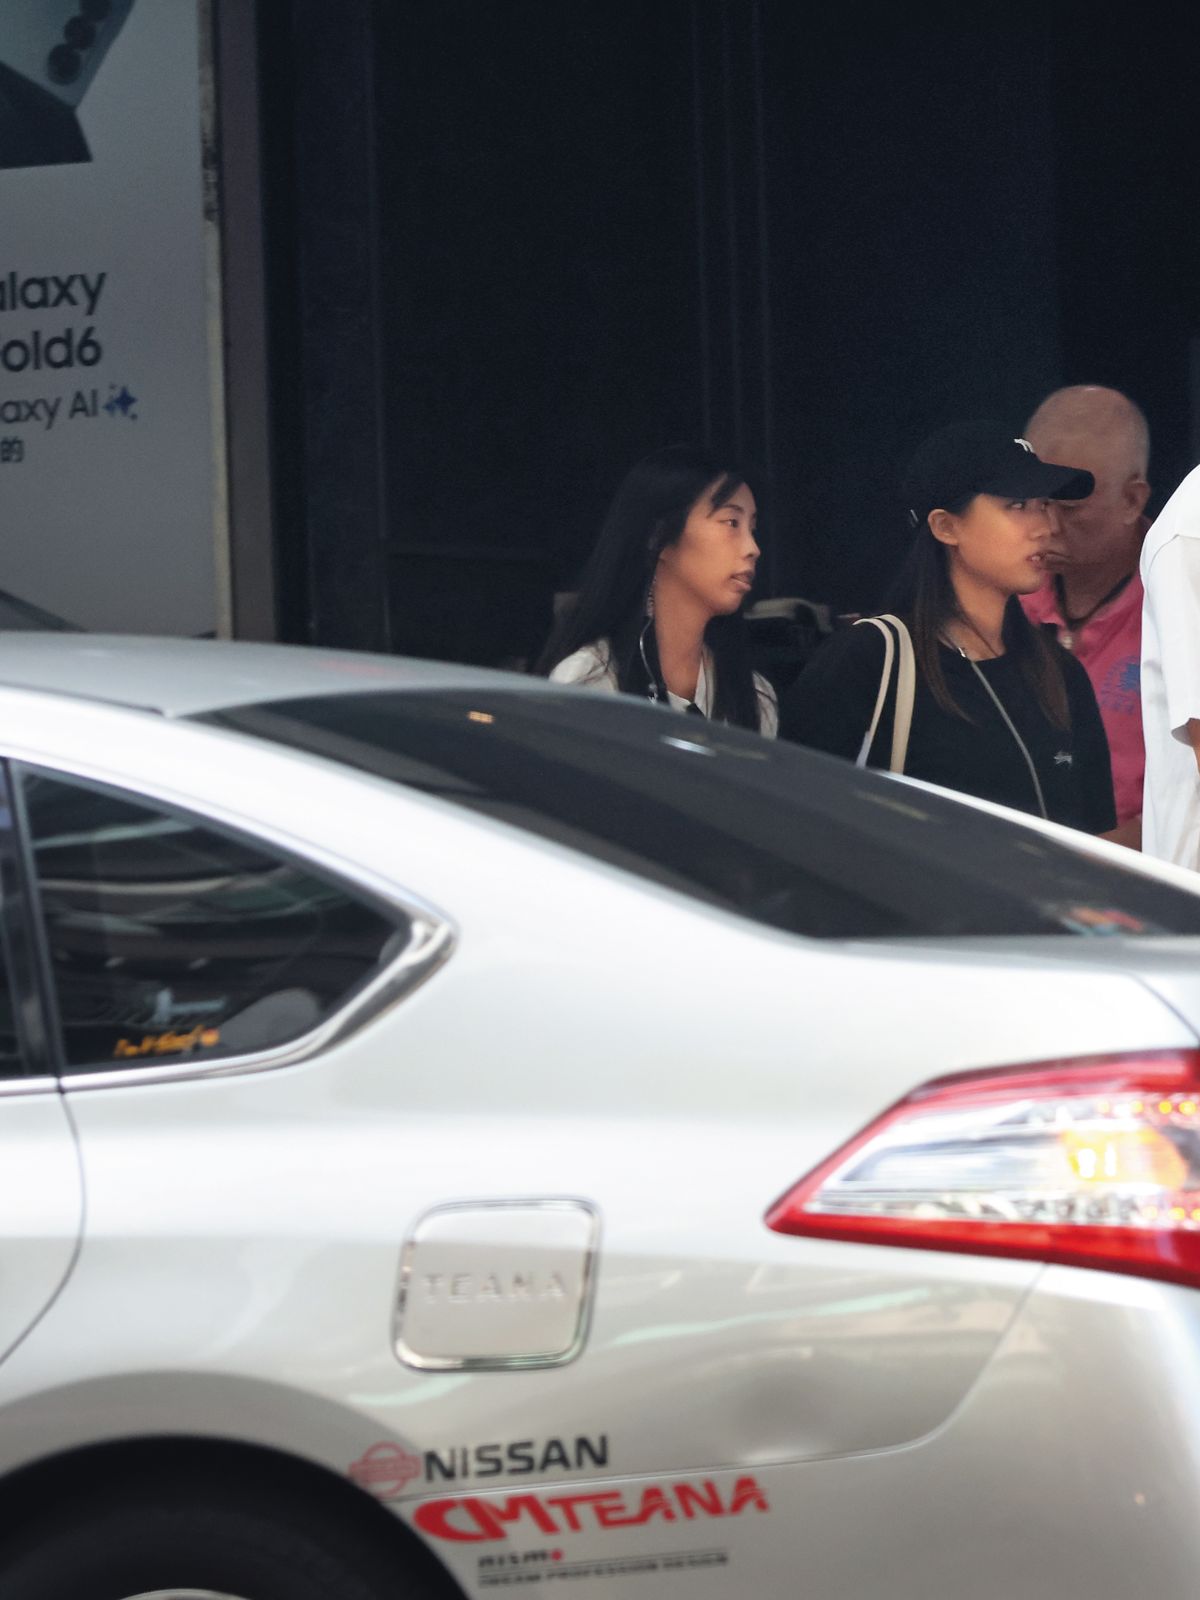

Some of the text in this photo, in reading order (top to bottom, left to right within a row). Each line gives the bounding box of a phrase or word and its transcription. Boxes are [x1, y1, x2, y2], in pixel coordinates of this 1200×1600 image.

[0, 271, 107, 316] laxy
[69, 389, 99, 419] AI
[424, 1270, 567, 1301] TEANA
[424, 1434, 609, 1483] NISSAN
